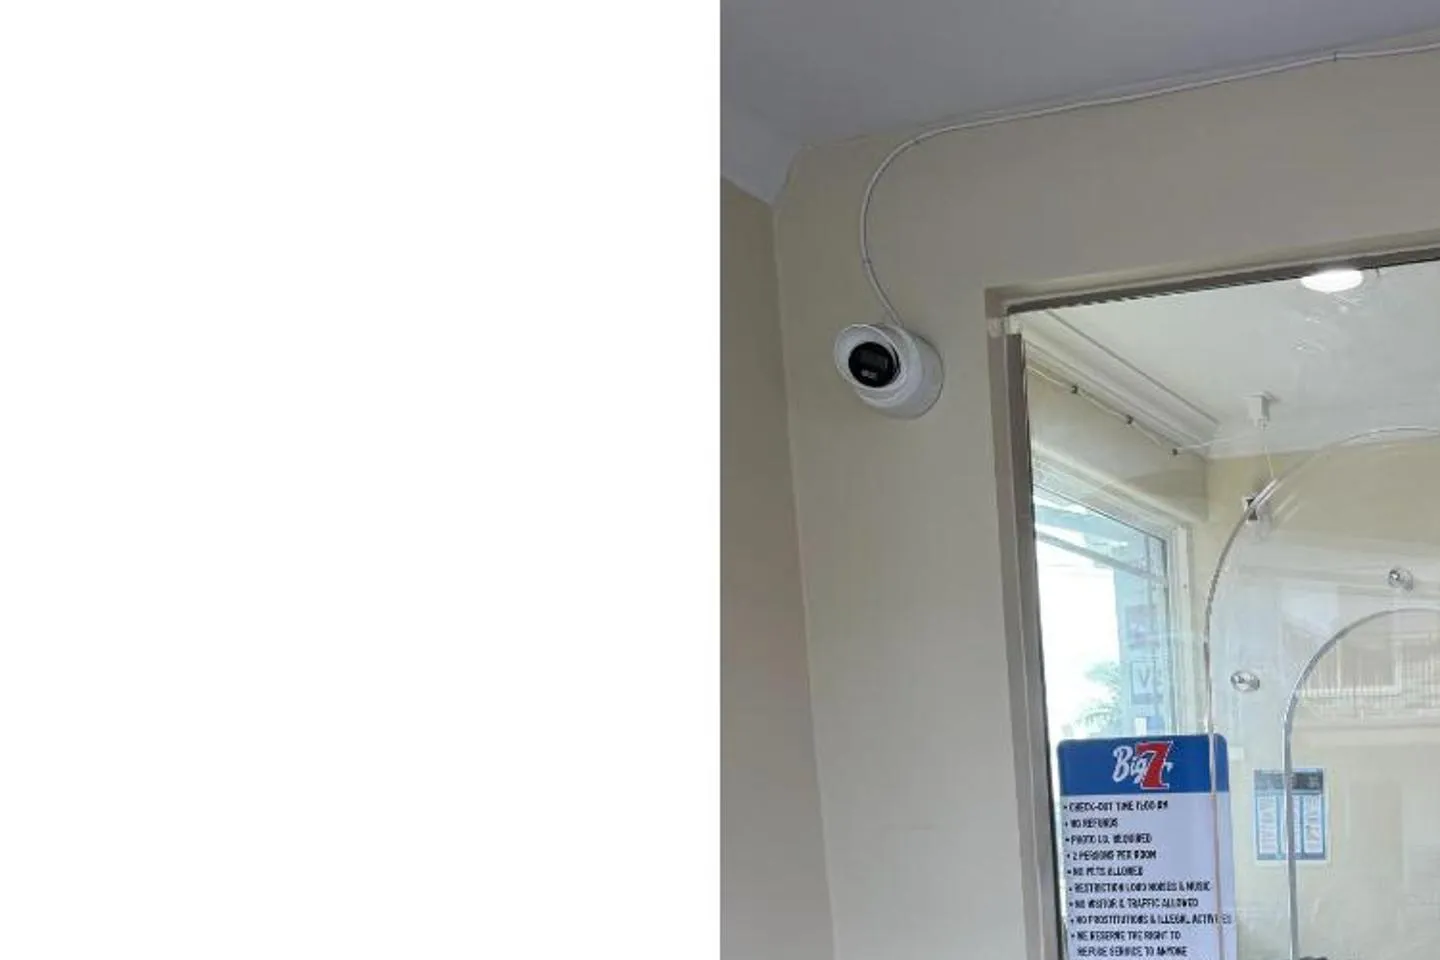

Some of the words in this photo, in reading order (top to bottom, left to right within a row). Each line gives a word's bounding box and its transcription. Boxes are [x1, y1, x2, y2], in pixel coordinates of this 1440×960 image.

[1112, 745, 1149, 784] Big
[1135, 740, 1174, 790] 7
[1070, 818, 1081, 828] NO
[1161, 898, 1199, 908] ALLOWED
[1076, 914, 1087, 924] NO
[1128, 931, 1144, 941] THE
[1170, 931, 1181, 940] TO
[1144, 947, 1155, 957] TO
